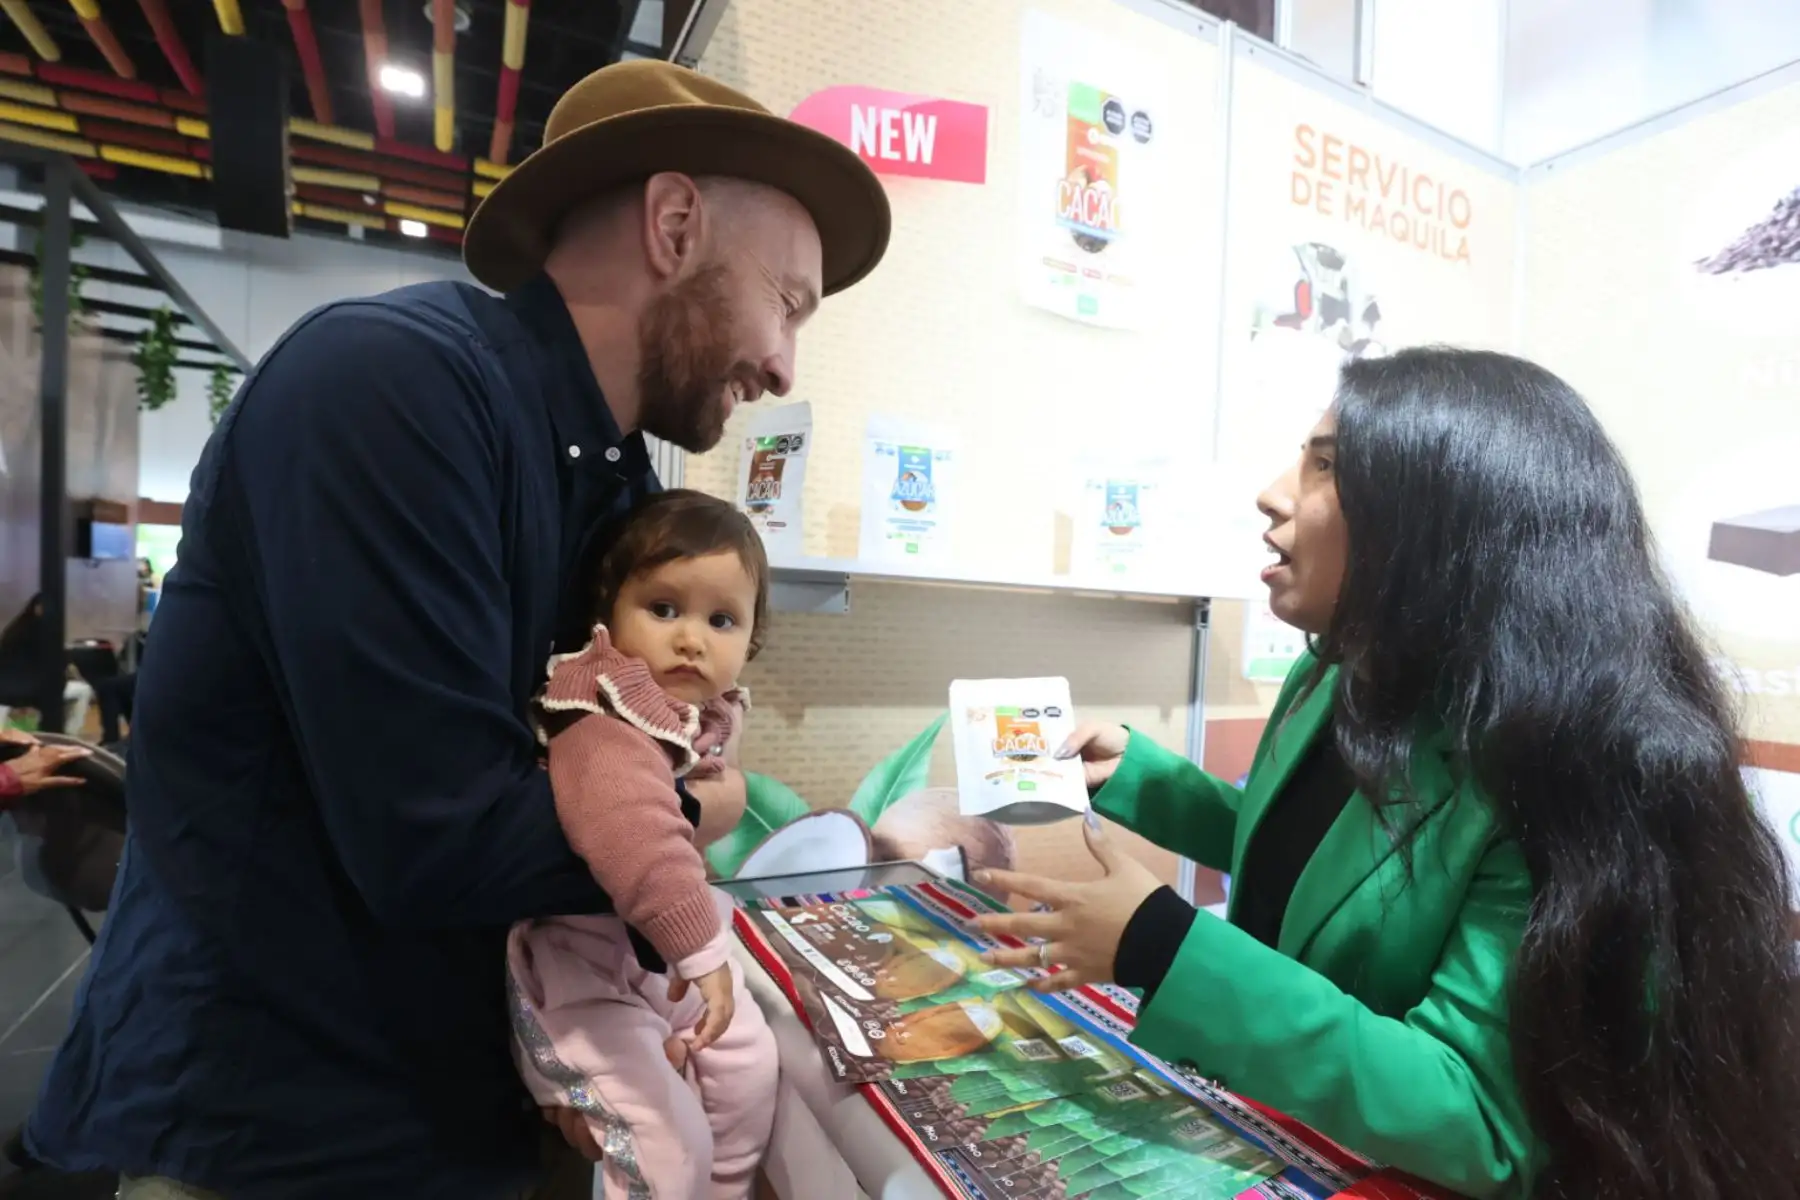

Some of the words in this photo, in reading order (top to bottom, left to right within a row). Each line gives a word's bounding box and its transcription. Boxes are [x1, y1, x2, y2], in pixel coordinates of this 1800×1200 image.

[850, 103, 937, 165] NEW
[1293, 123, 1473, 230] SERVICIO
[1290, 171, 1332, 217] DE
[1344, 193, 1473, 264] MAQUILA
[993, 736, 1048, 753] CACAO
